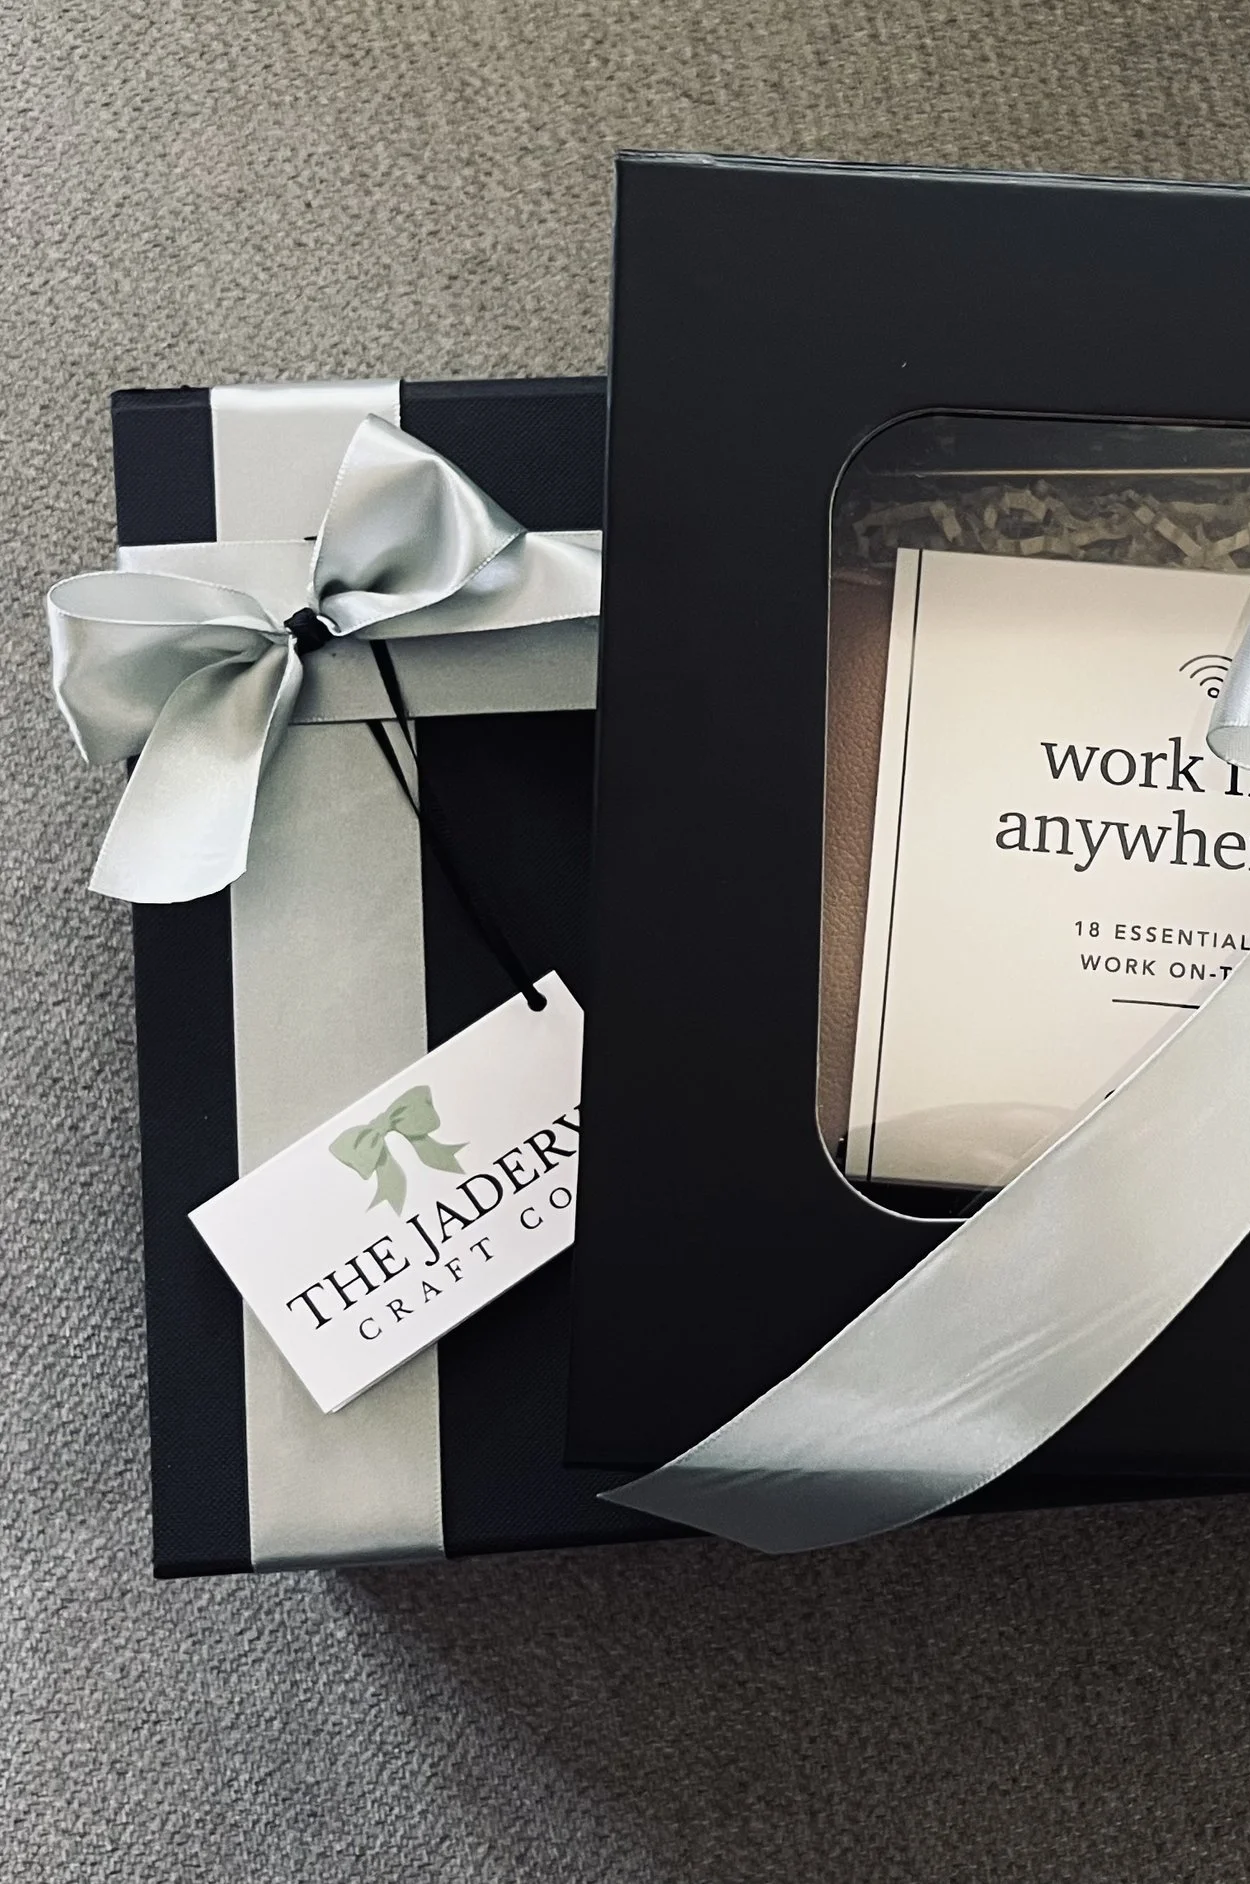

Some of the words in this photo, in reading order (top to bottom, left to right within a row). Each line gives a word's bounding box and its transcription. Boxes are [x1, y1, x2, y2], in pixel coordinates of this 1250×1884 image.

[1041, 737, 1206, 793] work
[1075, 921, 1100, 937] 18
[1081, 954, 1156, 976] WORK
[286, 1235, 410, 1330] THE
[358, 1237, 493, 1340] CRAFT
